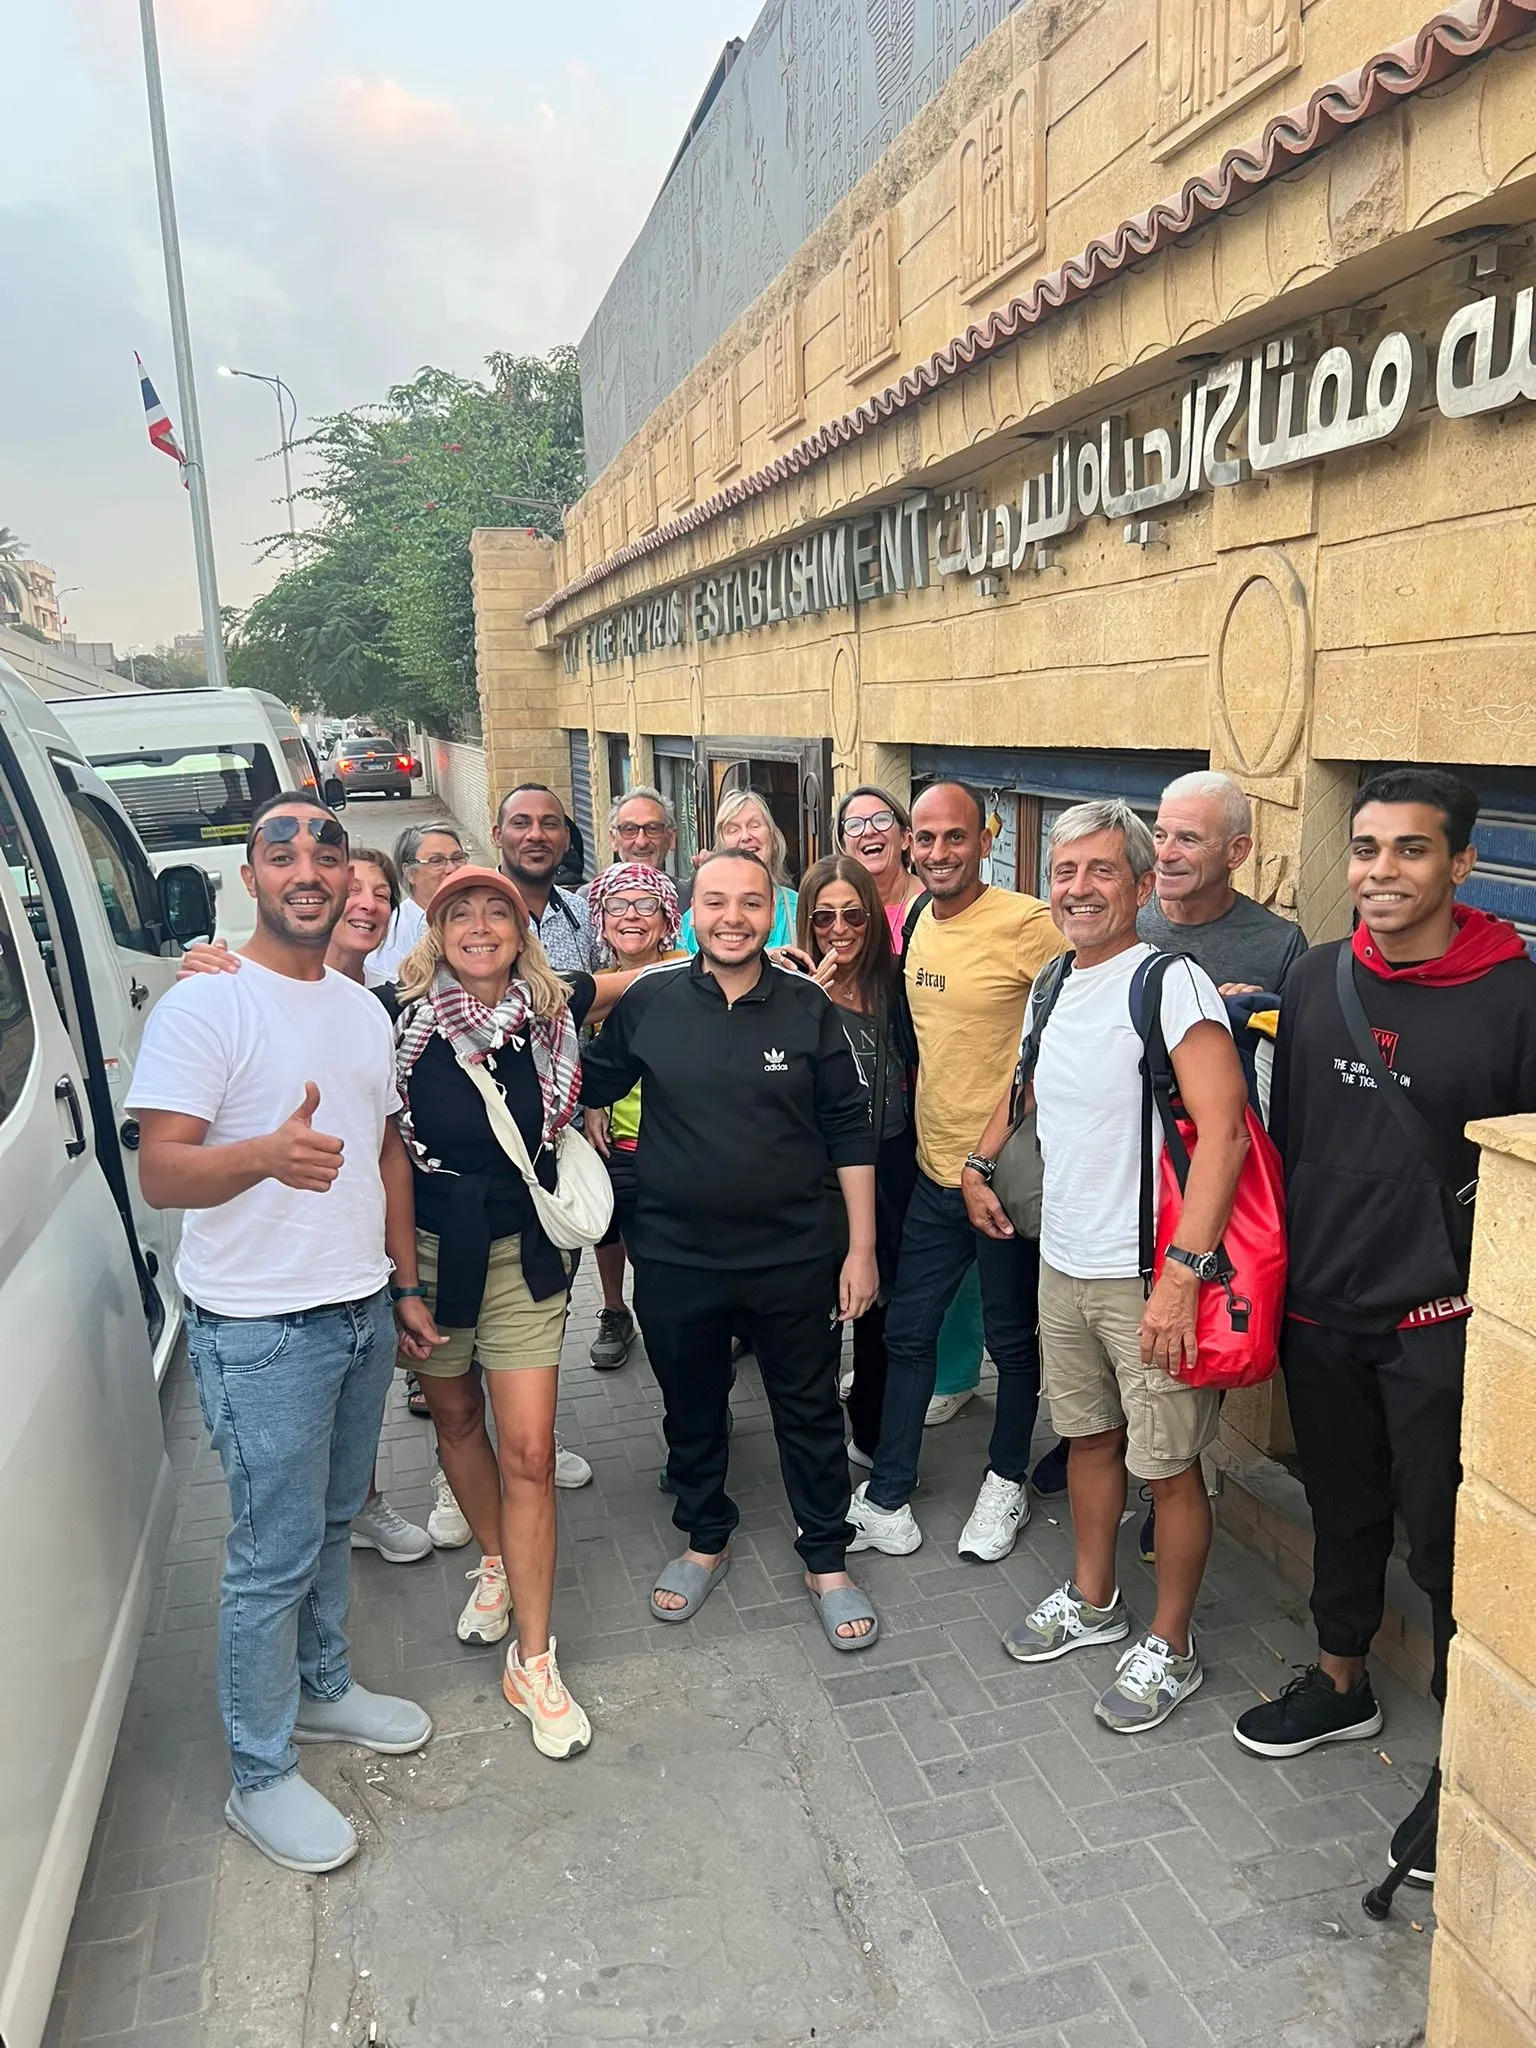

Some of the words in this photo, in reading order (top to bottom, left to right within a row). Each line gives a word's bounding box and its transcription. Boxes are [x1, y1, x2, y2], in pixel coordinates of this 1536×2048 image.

[1203, 331, 1413, 488] مفتاح
[691, 491, 930, 641] ESTABLISHMENT
[915, 967, 946, 993] Stray
[764, 1063, 789, 1072] adidas
[1333, 1058, 1348, 1071] THE
[1341, 1072, 1356, 1085] THE
